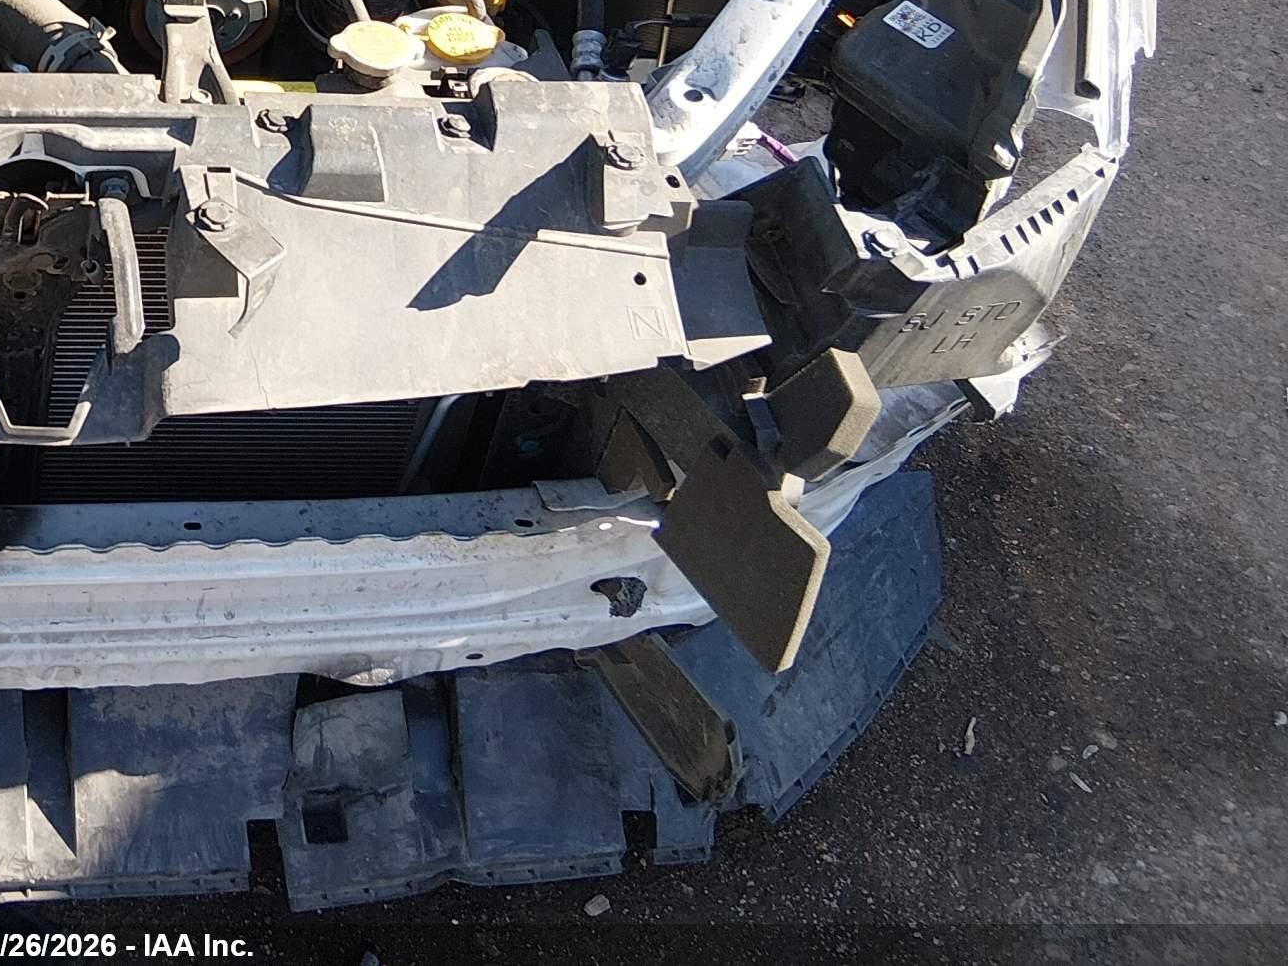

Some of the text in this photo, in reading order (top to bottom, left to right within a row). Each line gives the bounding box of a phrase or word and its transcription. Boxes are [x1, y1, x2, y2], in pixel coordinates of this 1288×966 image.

[914, 22, 942, 42] KD
[898, 300, 1022, 334] SJ STD
[929, 332, 978, 355] LH
